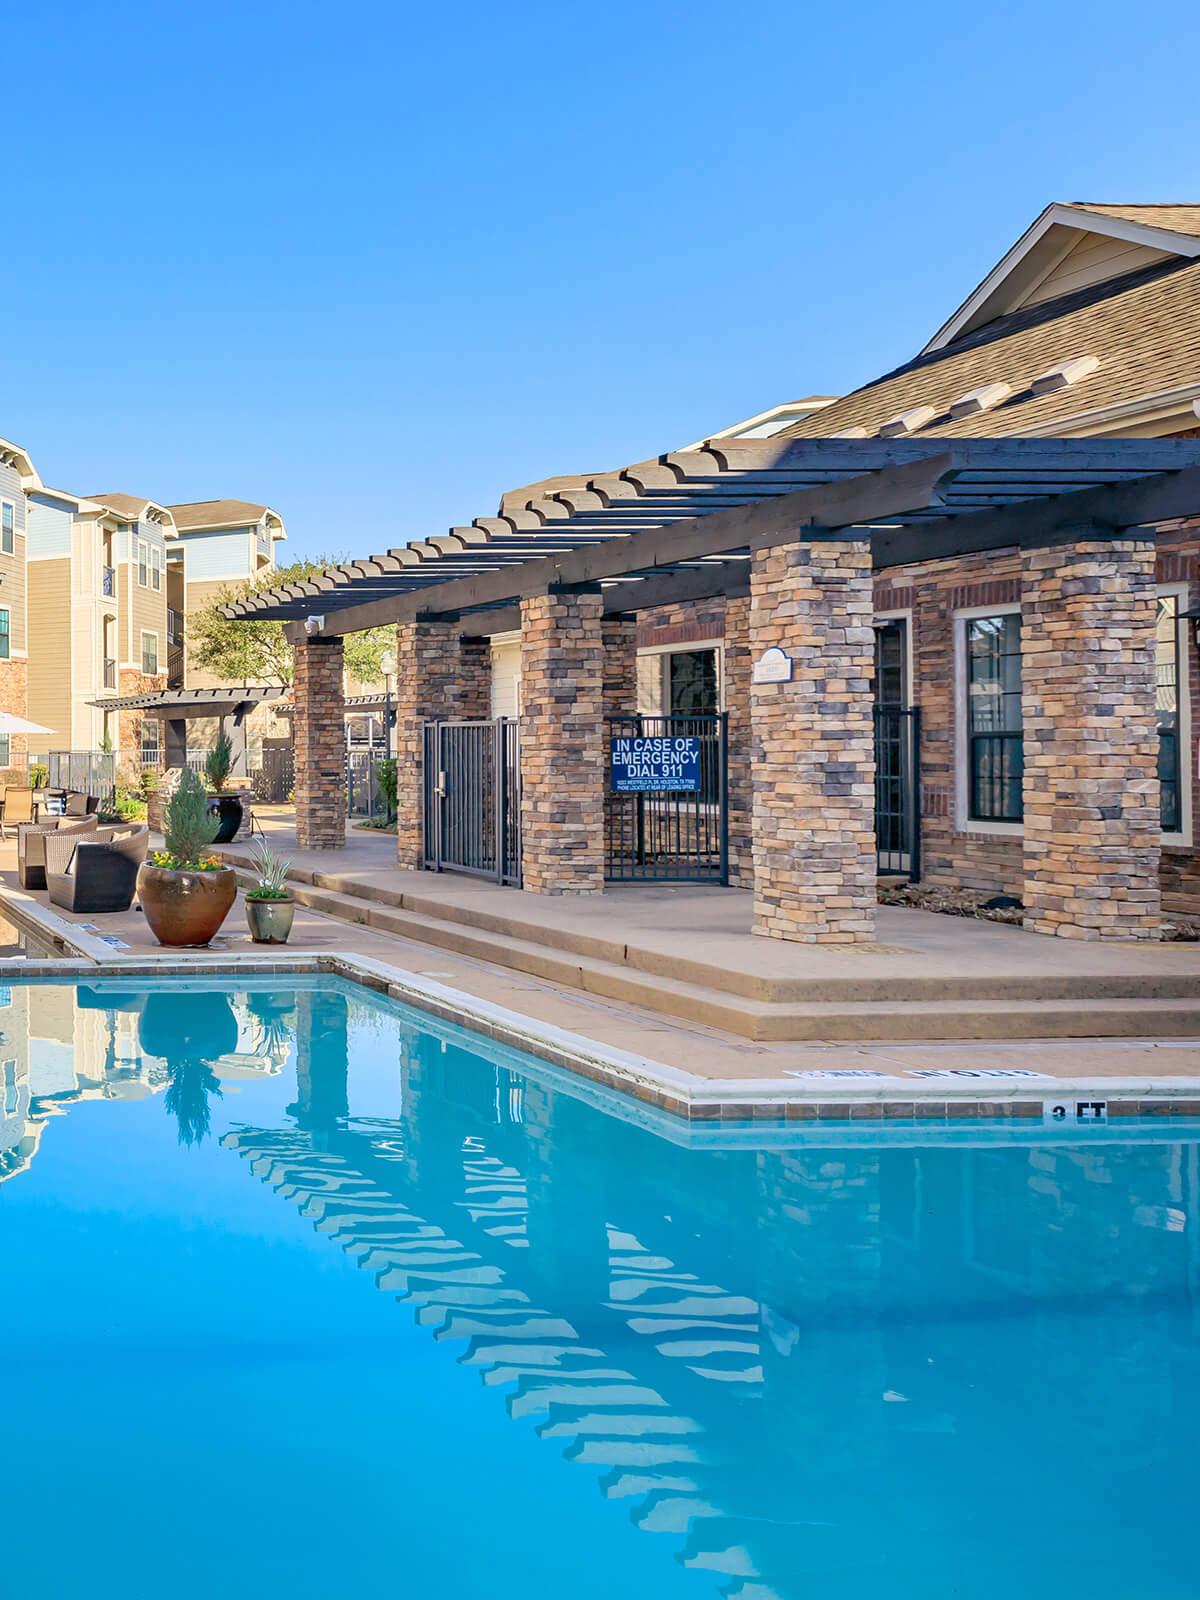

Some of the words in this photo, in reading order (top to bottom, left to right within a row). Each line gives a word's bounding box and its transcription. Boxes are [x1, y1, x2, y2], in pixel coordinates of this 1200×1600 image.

[616, 739, 630, 752] IN
[634, 739, 671, 752] CASE
[674, 738, 693, 751] OF
[612, 751, 699, 765] EMERGENCY
[627, 764, 659, 777] DIAL
[662, 764, 683, 777] 911
[1052, 1105, 1066, 1118] 3
[1076, 1101, 1106, 1117] FT
